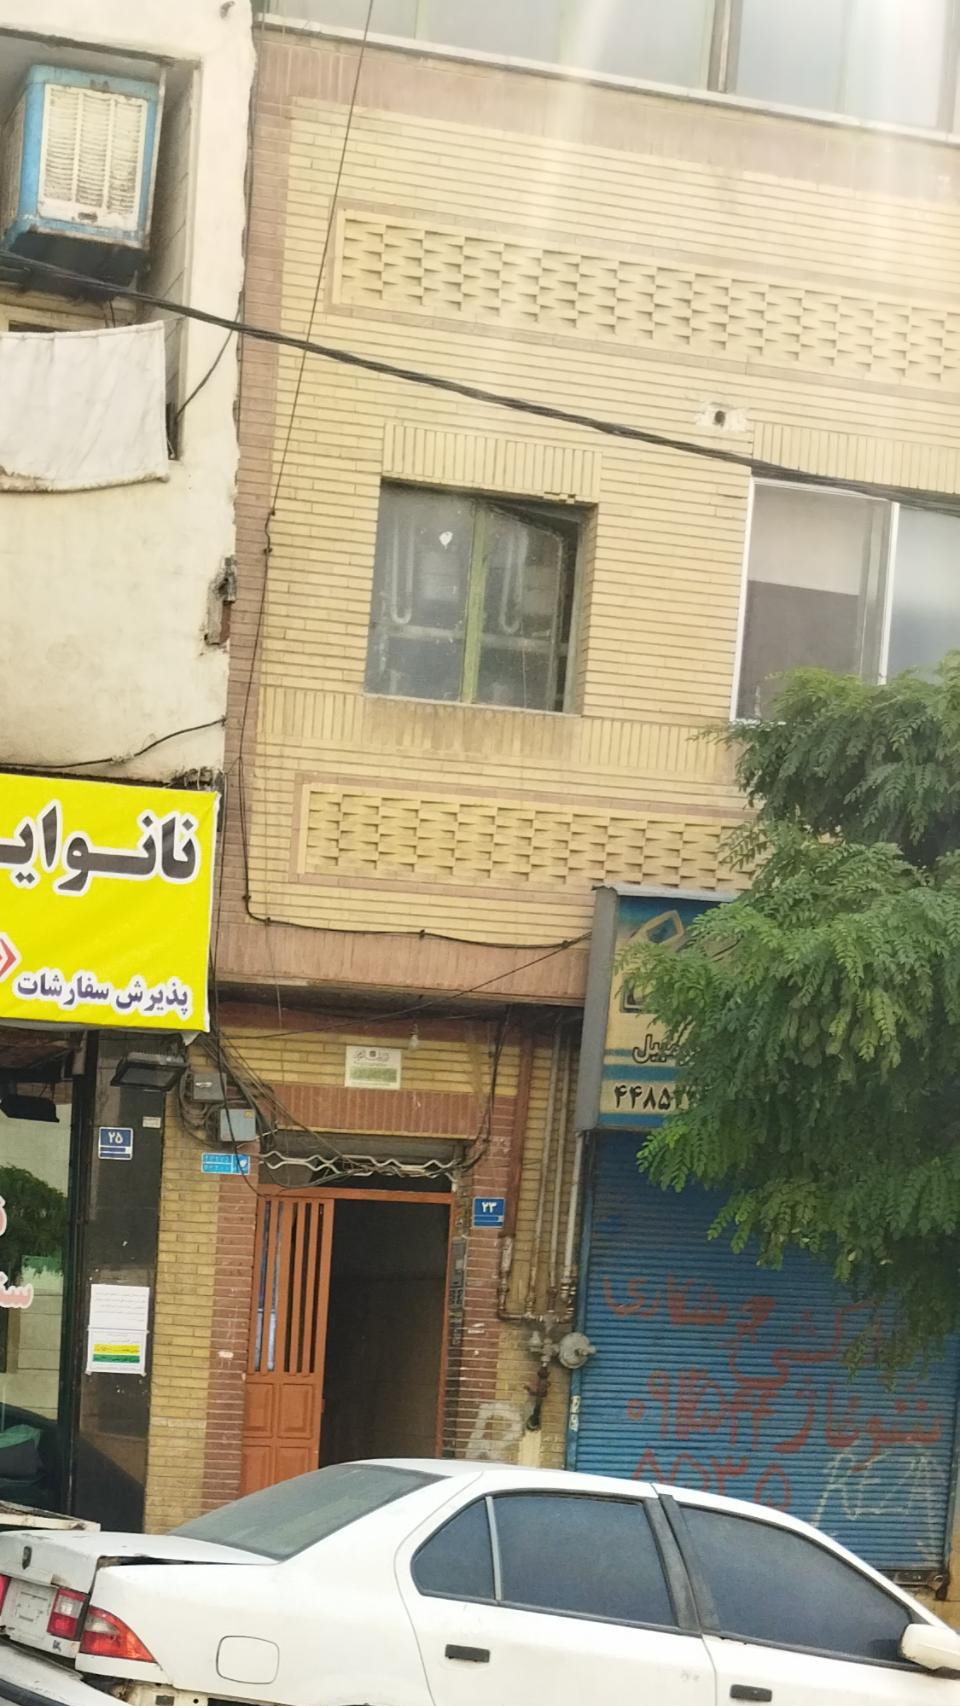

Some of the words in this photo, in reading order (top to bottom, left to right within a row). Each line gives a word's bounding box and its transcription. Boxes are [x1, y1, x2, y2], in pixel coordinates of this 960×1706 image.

[17, 972, 110, 1006] سفارشات
[115, 980, 189, 1015] پذیرش
[107, 1131, 124, 1144] ۲۵
[481, 1201, 497, 1214] ۲۳
